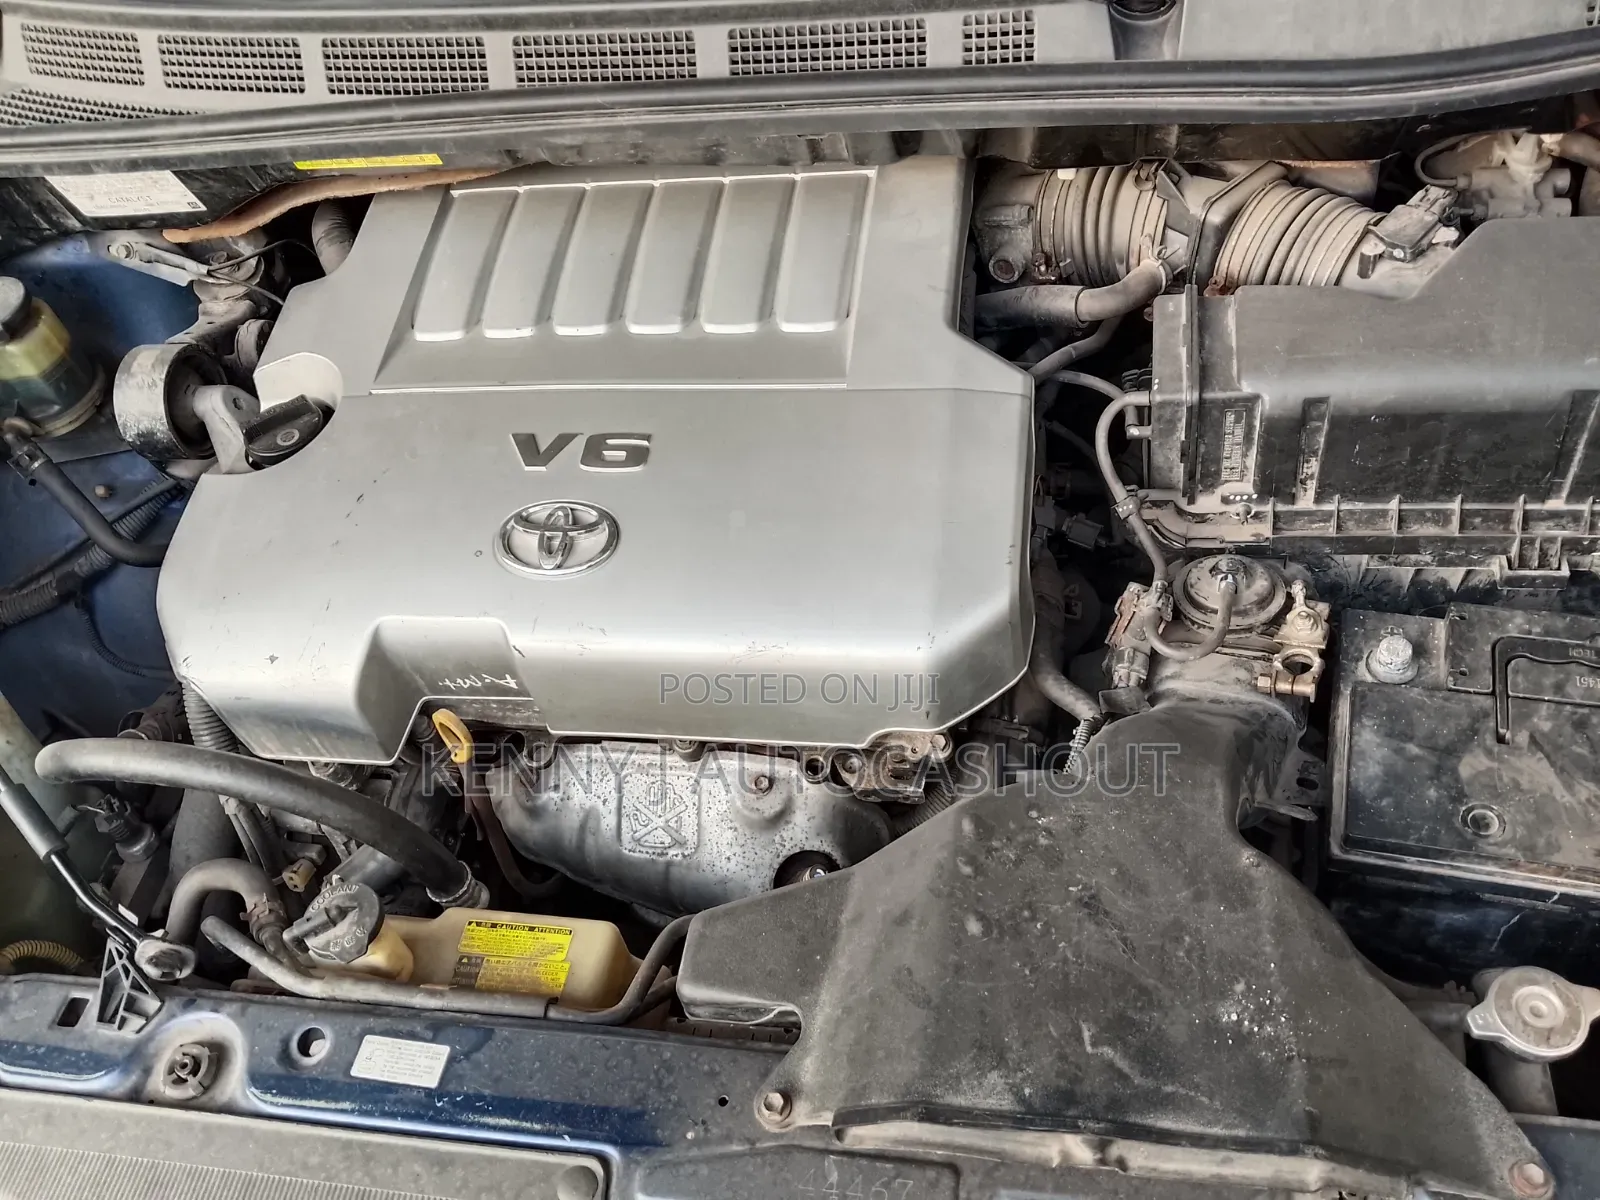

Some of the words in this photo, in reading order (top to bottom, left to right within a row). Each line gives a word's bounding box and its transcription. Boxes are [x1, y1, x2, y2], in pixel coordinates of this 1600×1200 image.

[108, 196, 153, 204] CATALYST
[510, 432, 652, 472] V6
[310, 884, 359, 912] COOLANT
[496, 923, 530, 932] CAUTION
[534, 926, 572, 935] ATTENTION
